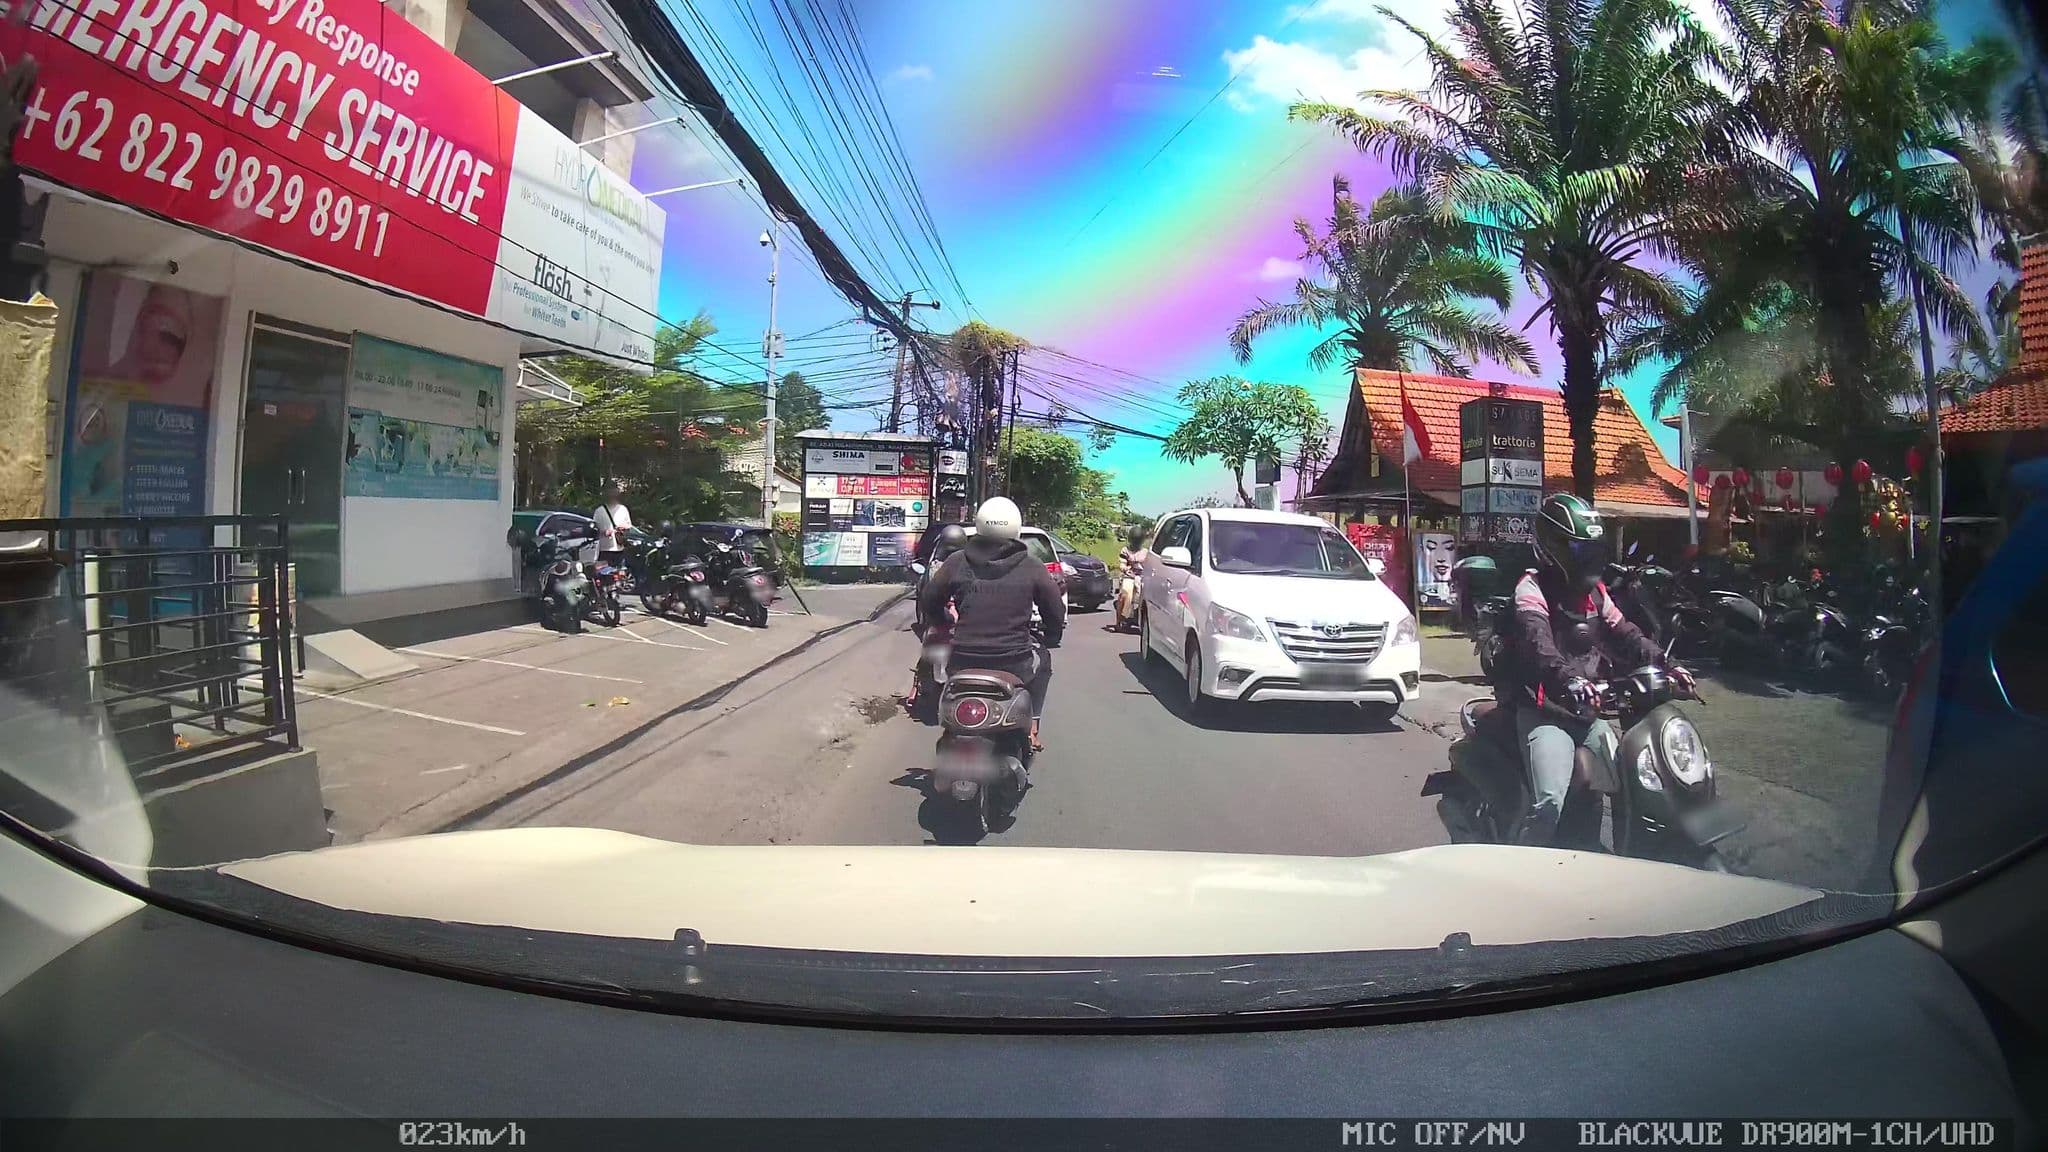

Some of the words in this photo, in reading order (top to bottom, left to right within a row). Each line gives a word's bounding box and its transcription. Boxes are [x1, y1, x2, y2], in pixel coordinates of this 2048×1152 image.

[295, 0, 420, 96] Response
[0, 0, 335, 142] ERGENCY
[324, 88, 494, 226] SERVICE
[24, 87, 114, 162] +62
[120, 113, 203, 192] 822
[209, 147, 304, 224] 9829
[309, 187, 390, 257] 8911
[551, 203, 559, 218] to
[560, 210, 575, 228] take
[576, 220, 590, 236] care
[590, 230, 598, 240] of
[597, 234, 608, 246] you
[513, 282, 548, 307] Professional
[832, 450, 865, 459] SHIMA
[1492, 433, 1536, 449] trattoria
